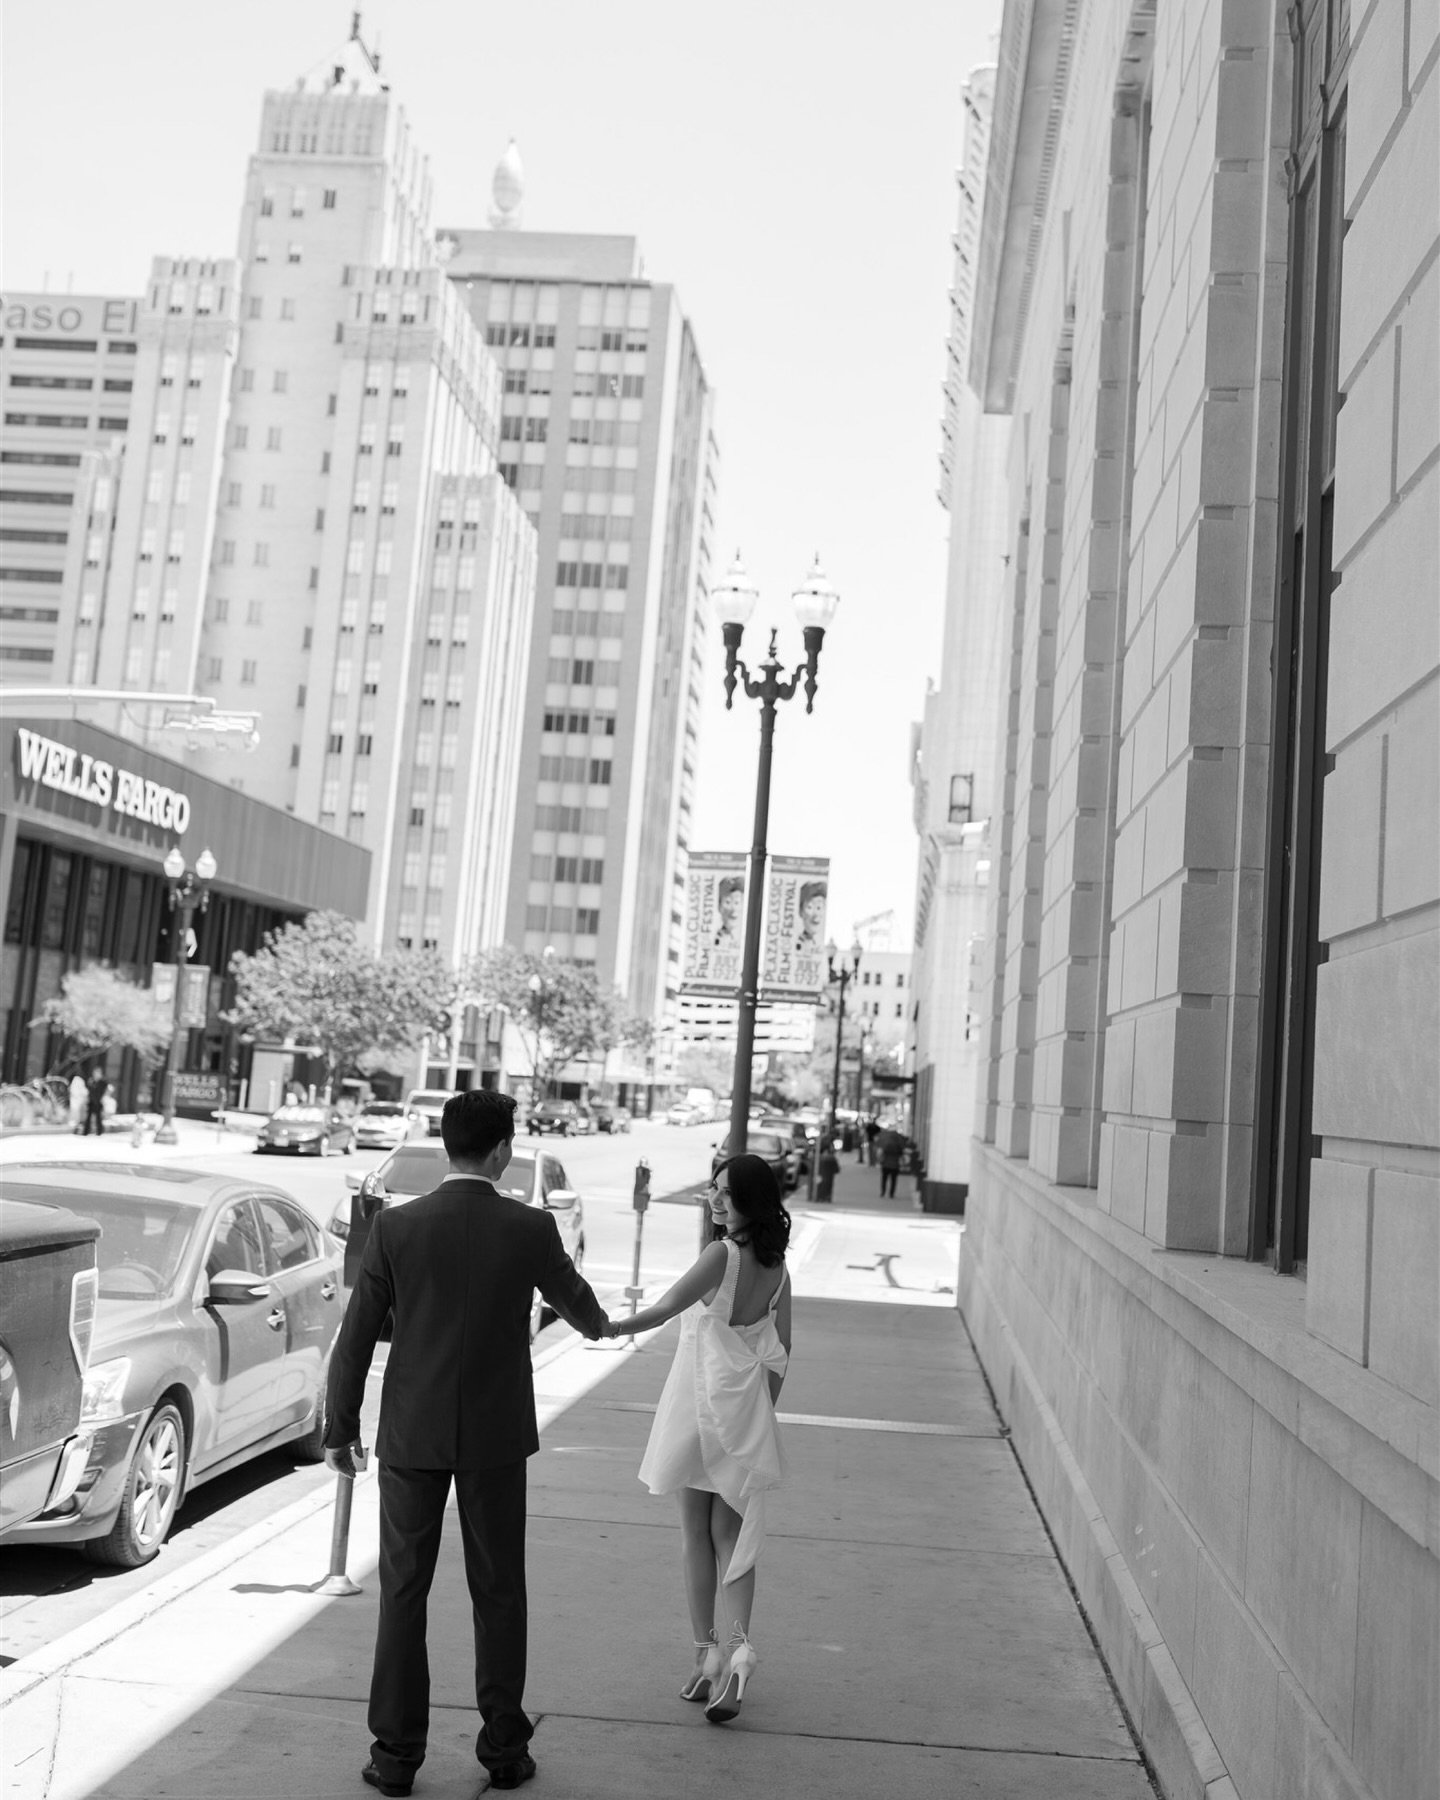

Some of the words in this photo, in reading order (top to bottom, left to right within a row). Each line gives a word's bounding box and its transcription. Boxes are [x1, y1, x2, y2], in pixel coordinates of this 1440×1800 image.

[0, 298, 82, 332] aso
[18, 728, 113, 807] WELLS
[114, 770, 190, 834] FARGO
[701, 875, 714, 933] FESTIVAL
[781, 879, 796, 938] FESTIVAL
[696, 949, 710, 978] FILM
[778, 953, 791, 983] FILM
